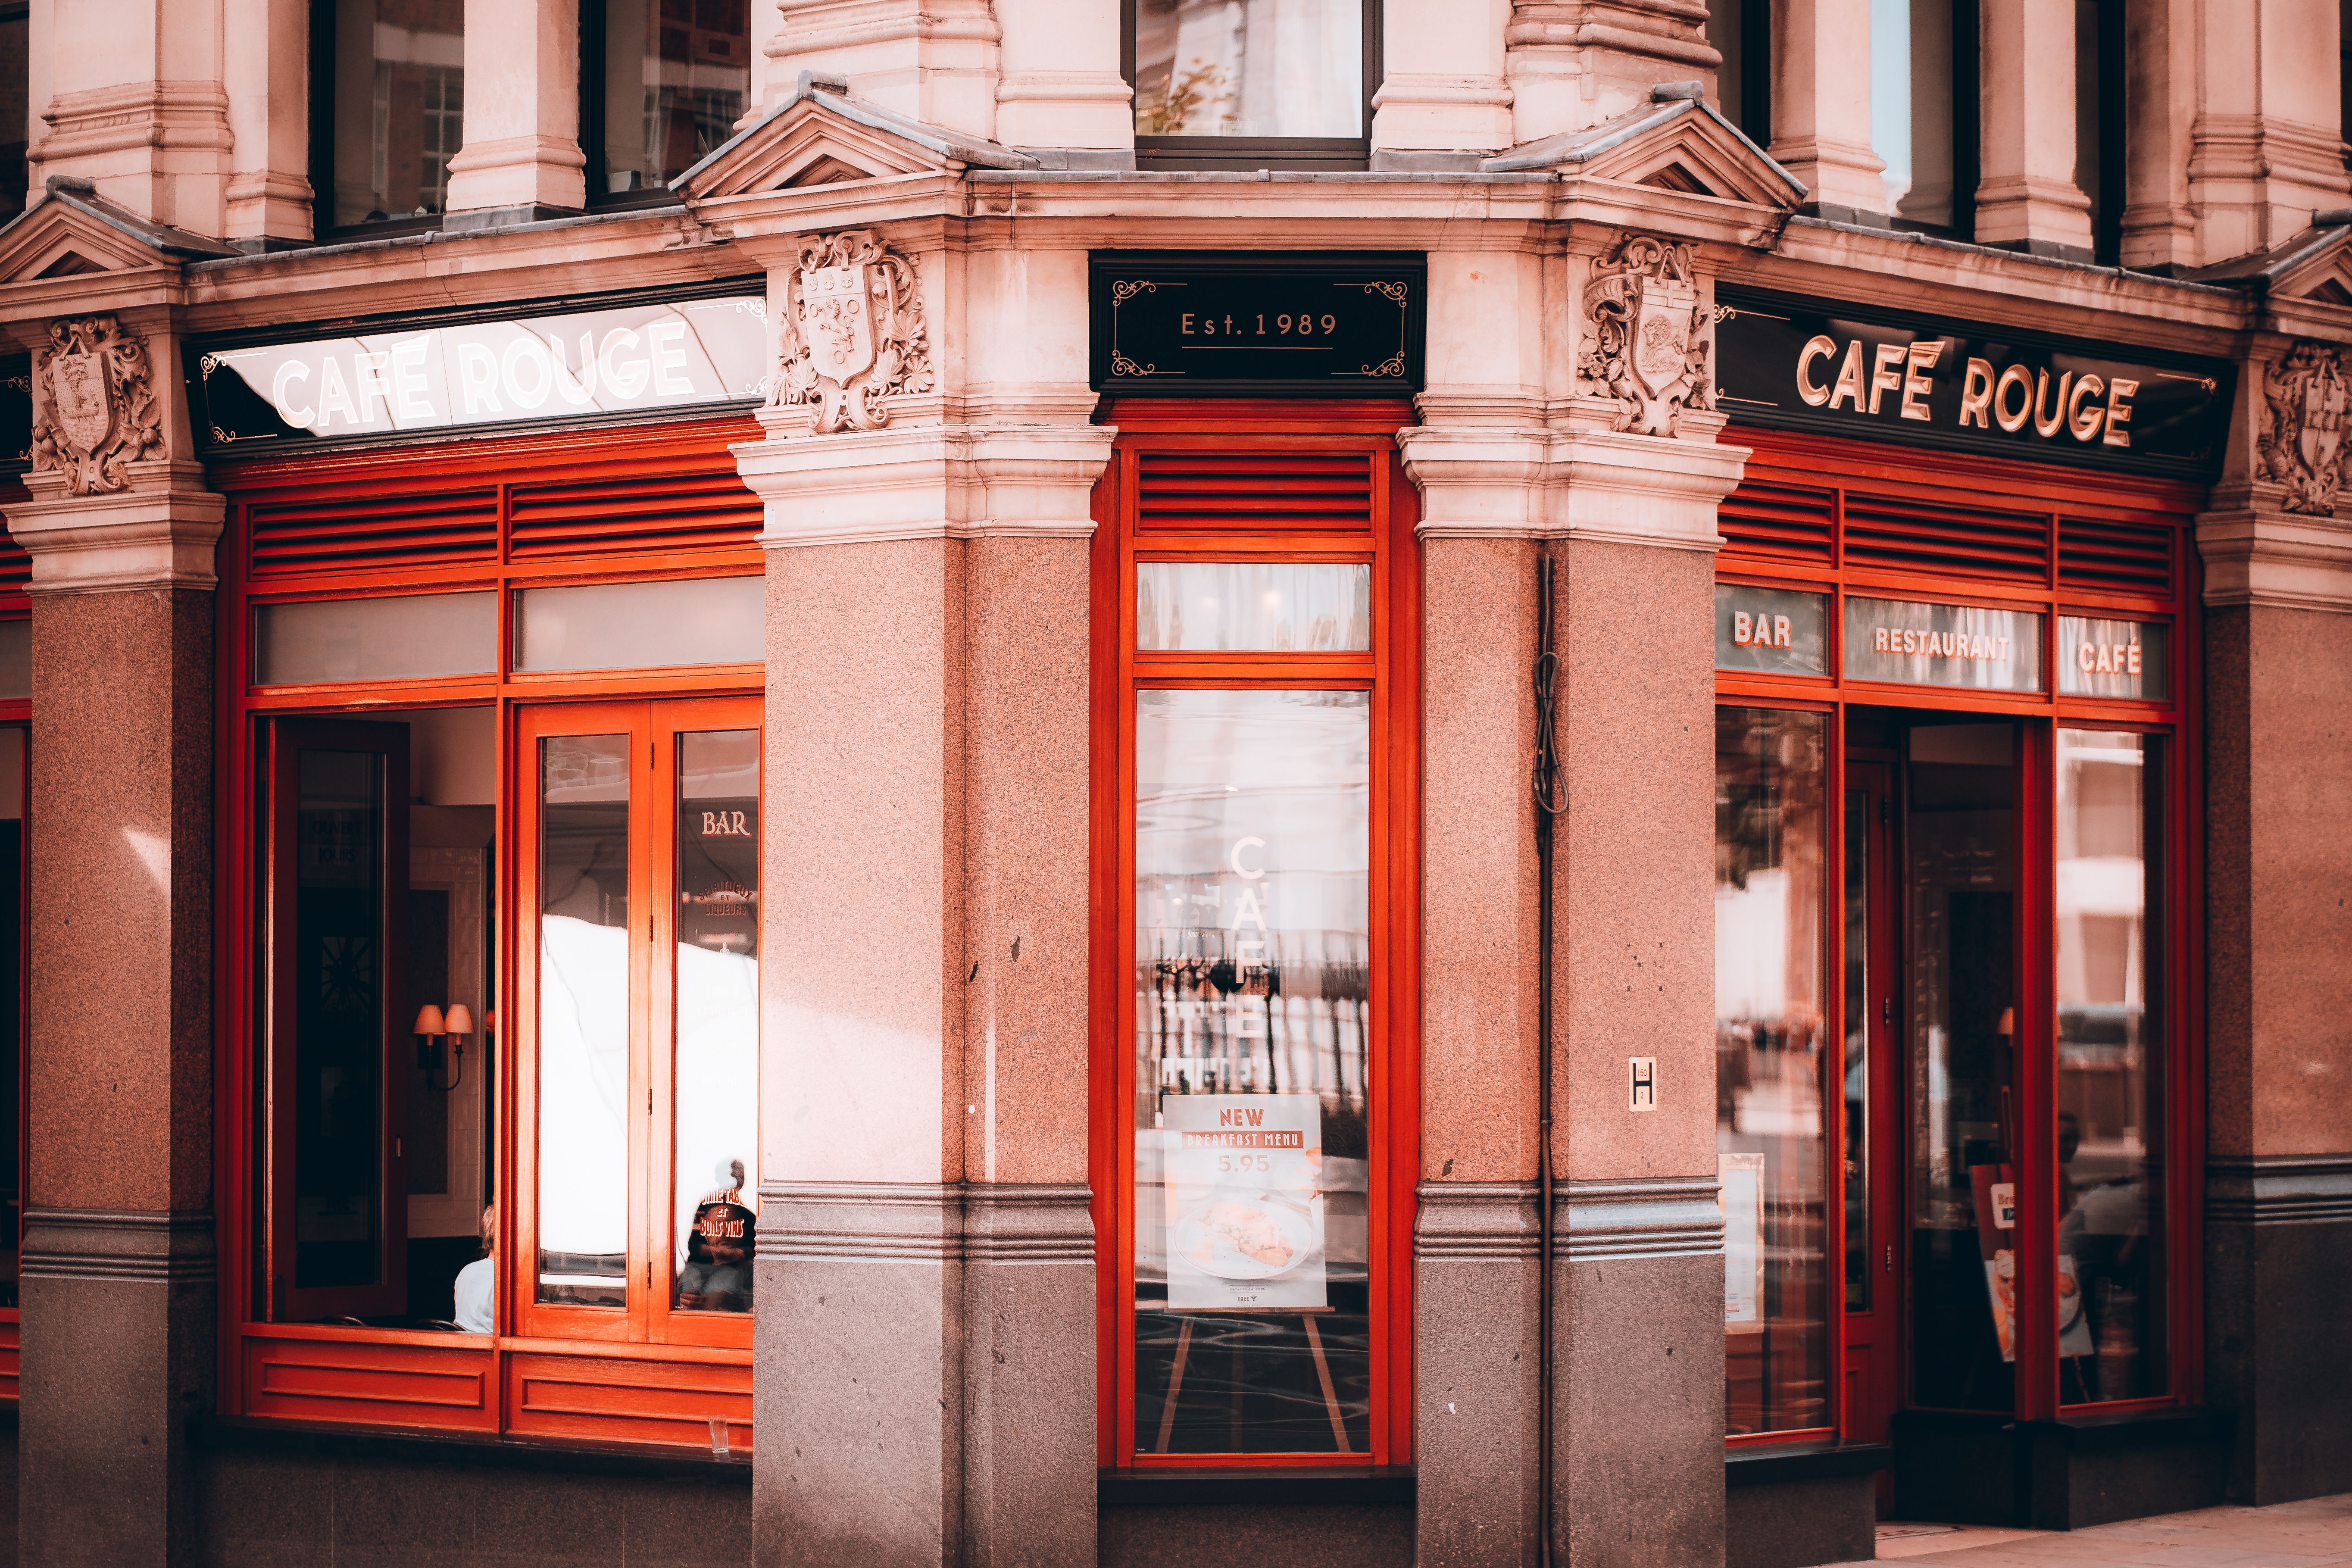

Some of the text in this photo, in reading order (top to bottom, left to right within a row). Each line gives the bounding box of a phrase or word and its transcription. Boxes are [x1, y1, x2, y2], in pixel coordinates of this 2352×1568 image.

[458, 321, 695, 414] ROUGE
[1959, 357, 2141, 447] ROUGE
[1734, 610, 1792, 649] BAR
[1875, 627, 2009, 661] RESTAURANT
[2078, 636, 2142, 675] CAFÉ
[702, 811, 752, 837] BAR
[1230, 836, 1267, 1038] CAFE
[1633, 1062, 1652, 1105] H
[1219, 1108, 1264, 1127] NEW
[1187, 1133, 1299, 1146] BREAKFAST MENU
[1218, 1155, 1269, 1172] 5.95
[700, 1217, 745, 1238] BONS VINS
[716, 1206, 728, 1218] ET
